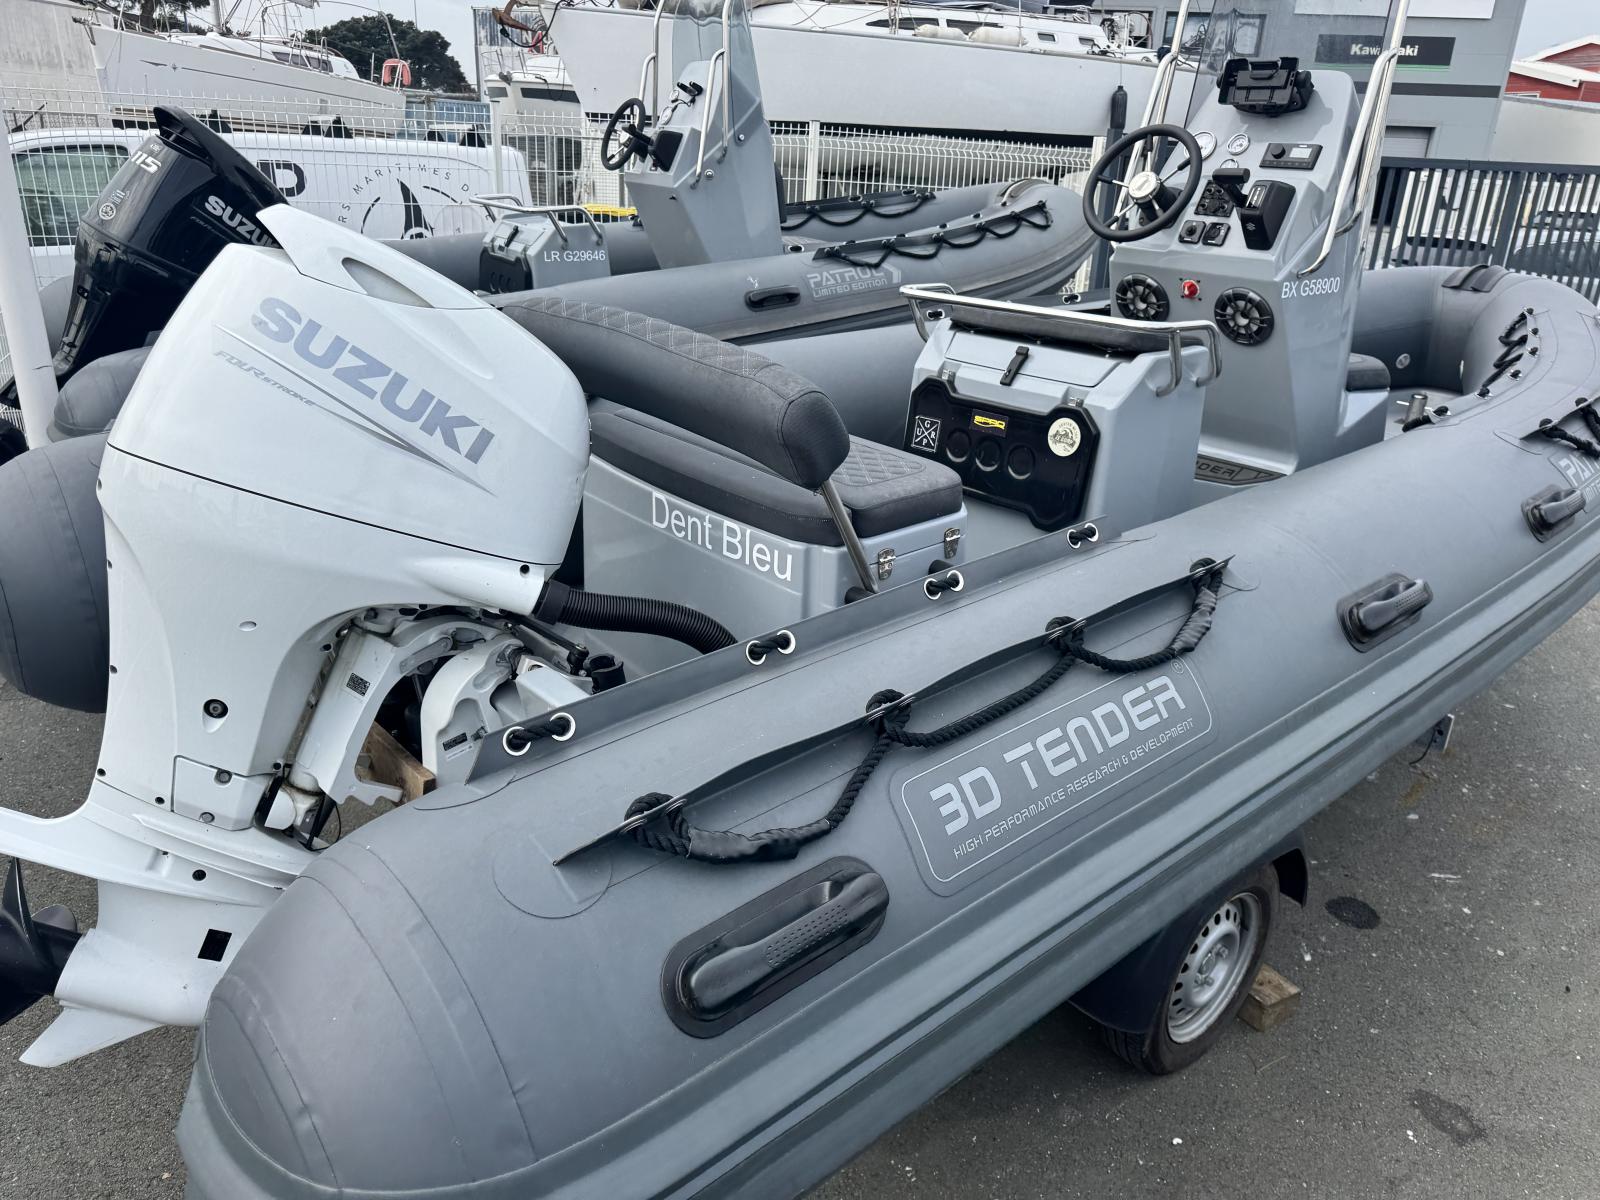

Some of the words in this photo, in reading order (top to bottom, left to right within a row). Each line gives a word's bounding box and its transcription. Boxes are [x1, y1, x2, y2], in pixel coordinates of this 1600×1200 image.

[1350, 43, 1420, 57] Kawaki
[131, 151, 161, 174] 115
[352, 163, 452, 195] MARITIMES
[544, 250, 561, 262] LR
[563, 250, 606, 262] G29646
[813, 285, 850, 298] LIMITED
[852, 278, 888, 292] EDITION
[1281, 281, 1299, 299] BX
[1300, 276, 1341, 297] G58900
[250, 297, 495, 465] SUZUKI
[652, 491, 713, 550] Dent
[722, 519, 793, 582] Bleu
[929, 766, 1002, 836] 3D
[1003, 675, 1187, 790] TENDER
[953, 834, 984, 860] HIGH
[984, 787, 1066, 842] PERFORMANCE
[1067, 758, 1121, 796] RESEARCH
[1122, 753, 1130, 766] &
[1131, 717, 1195, 761] DEVELOPMENT
